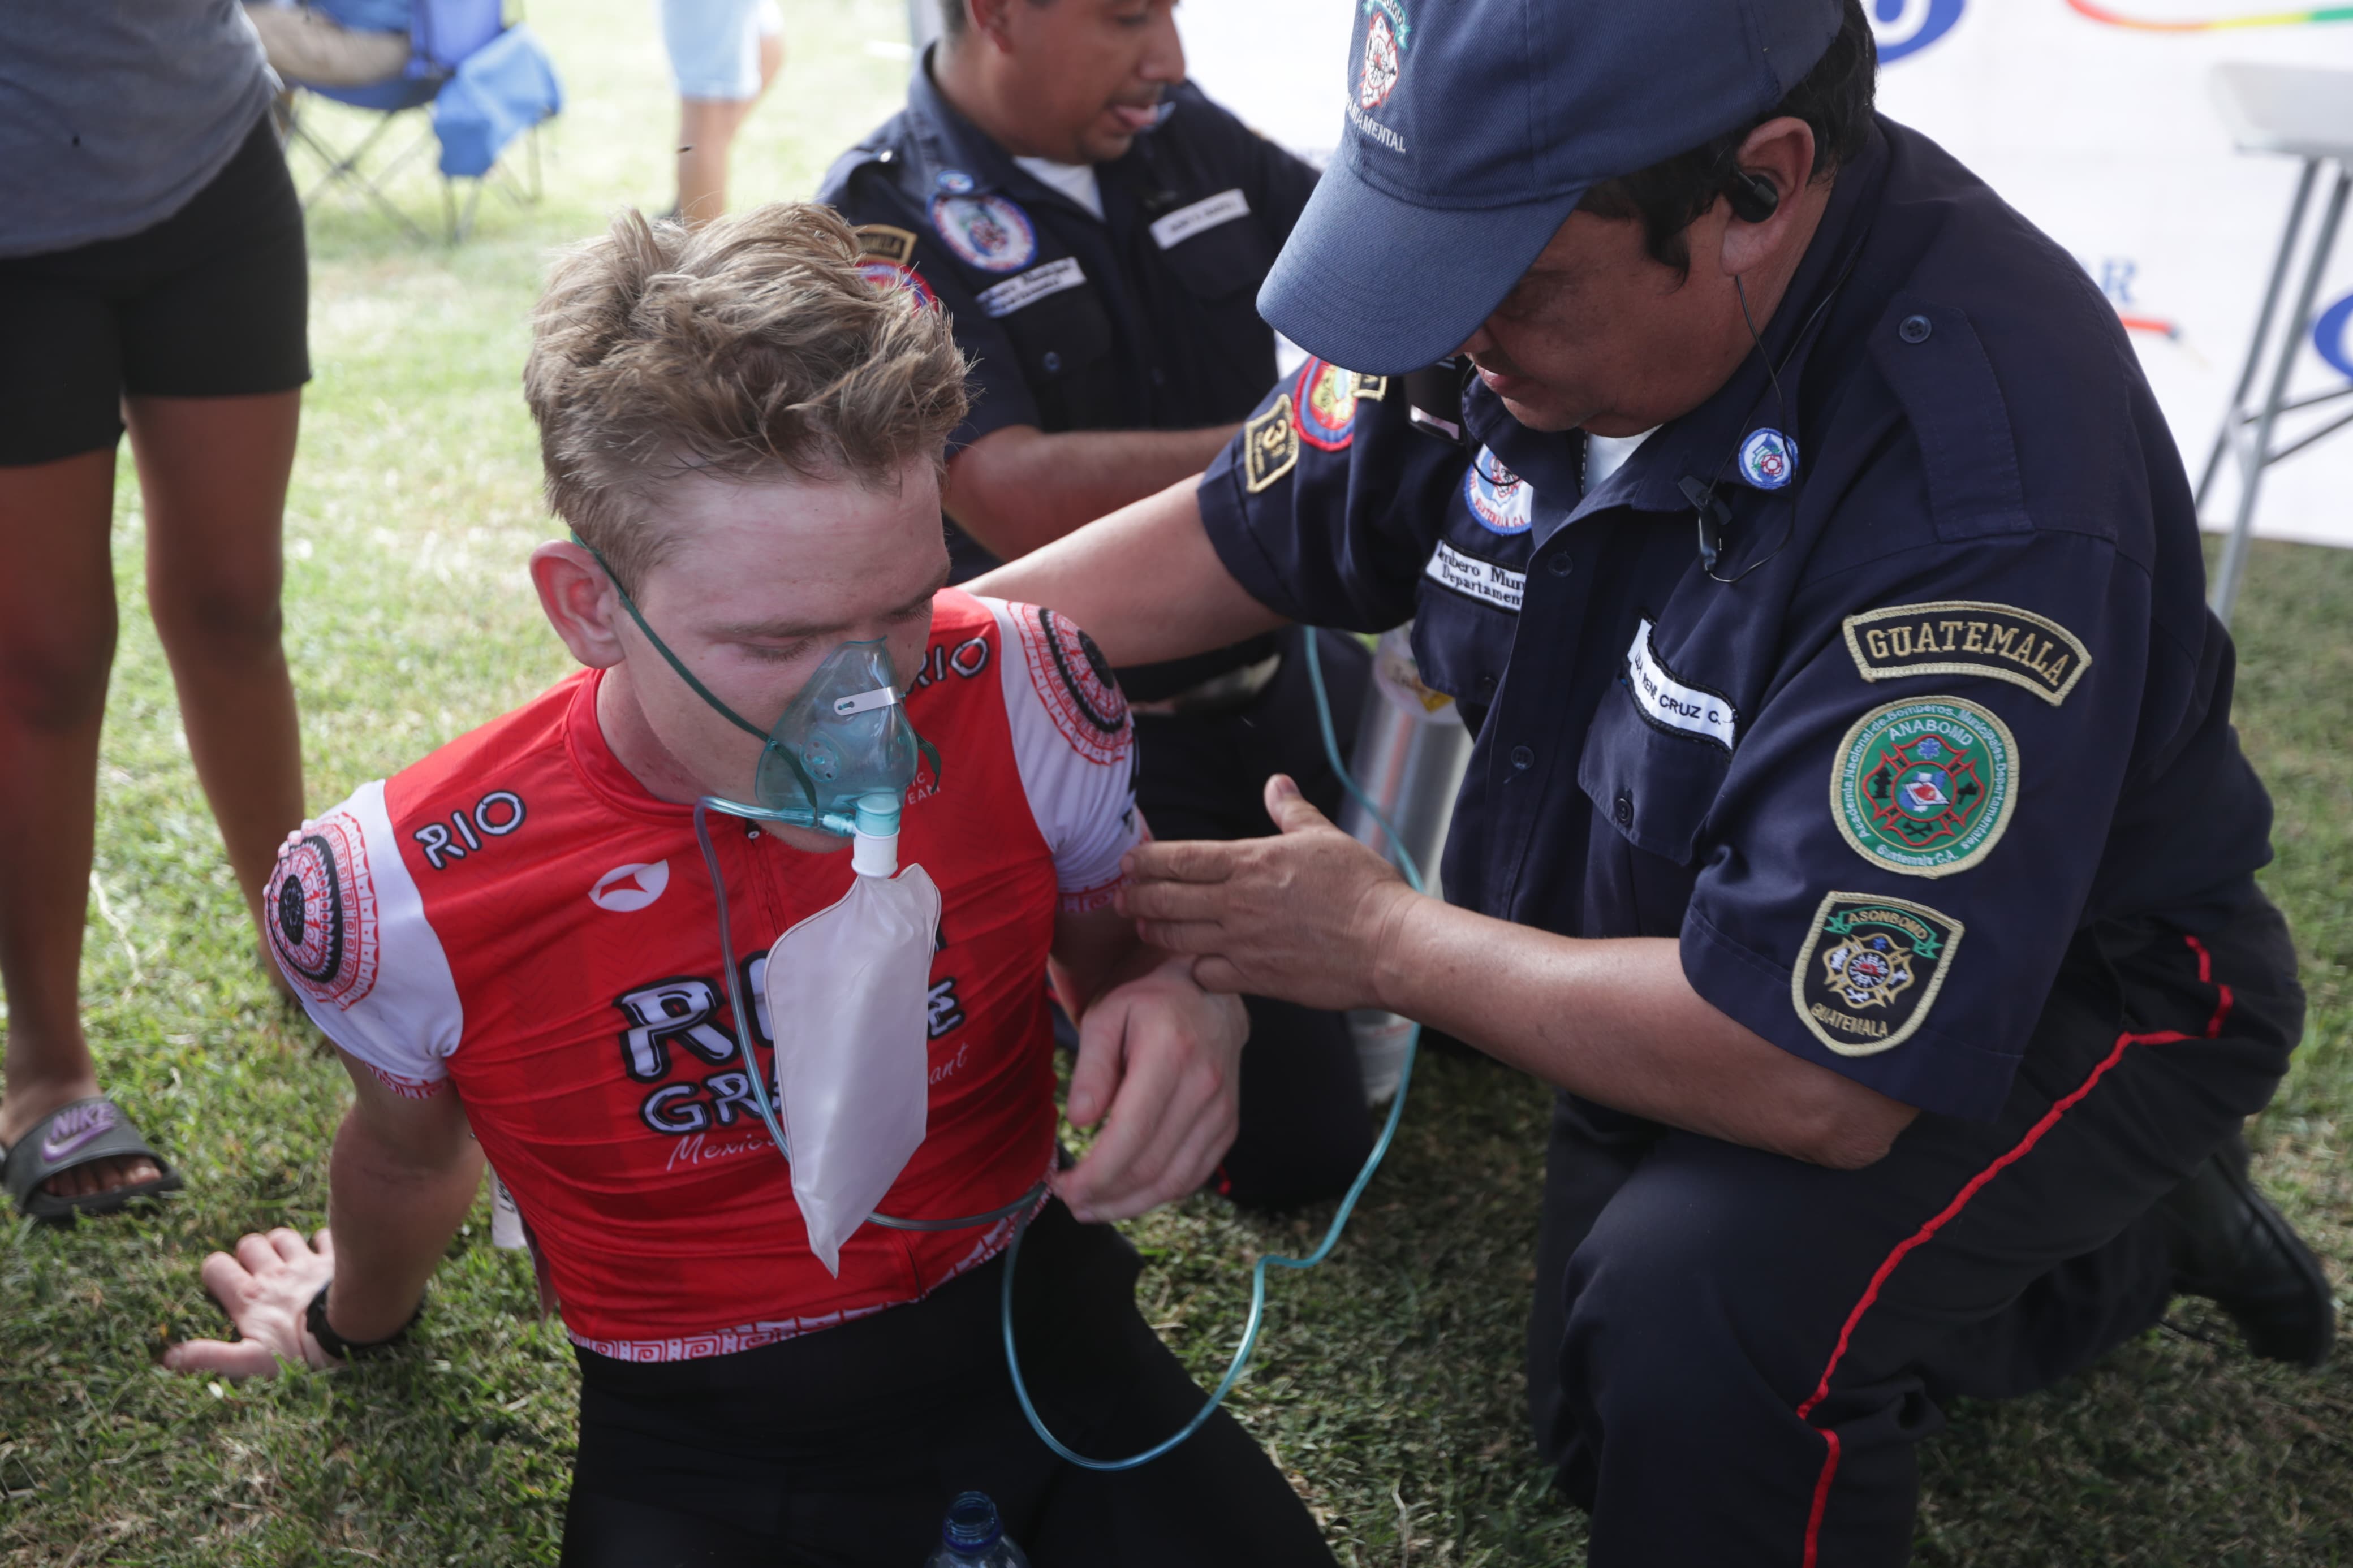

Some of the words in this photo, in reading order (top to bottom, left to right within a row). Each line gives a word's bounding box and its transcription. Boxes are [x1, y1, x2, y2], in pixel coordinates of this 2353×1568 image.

[1442, 564, 1523, 606] Departamen
[1867, 621, 2070, 686] GUATEMALA
[1660, 694, 1701, 719] CRUZ
[1708, 710, 1721, 725] C.
[1843, 727, 1874, 779] Nacional
[1872, 718, 1886, 731] de
[1887, 705, 1954, 720] Bomberos
[1889, 719, 1973, 745] ANABOMD
[903, 785, 941, 808] EAM
[413, 790, 527, 870] RIO
[1876, 844, 1933, 866] Guatemala
[1848, 910, 1928, 939] ASONBOMD
[1810, 1003, 1888, 1037] GUATEMALA
[52, 1103, 113, 1141] NIKE
